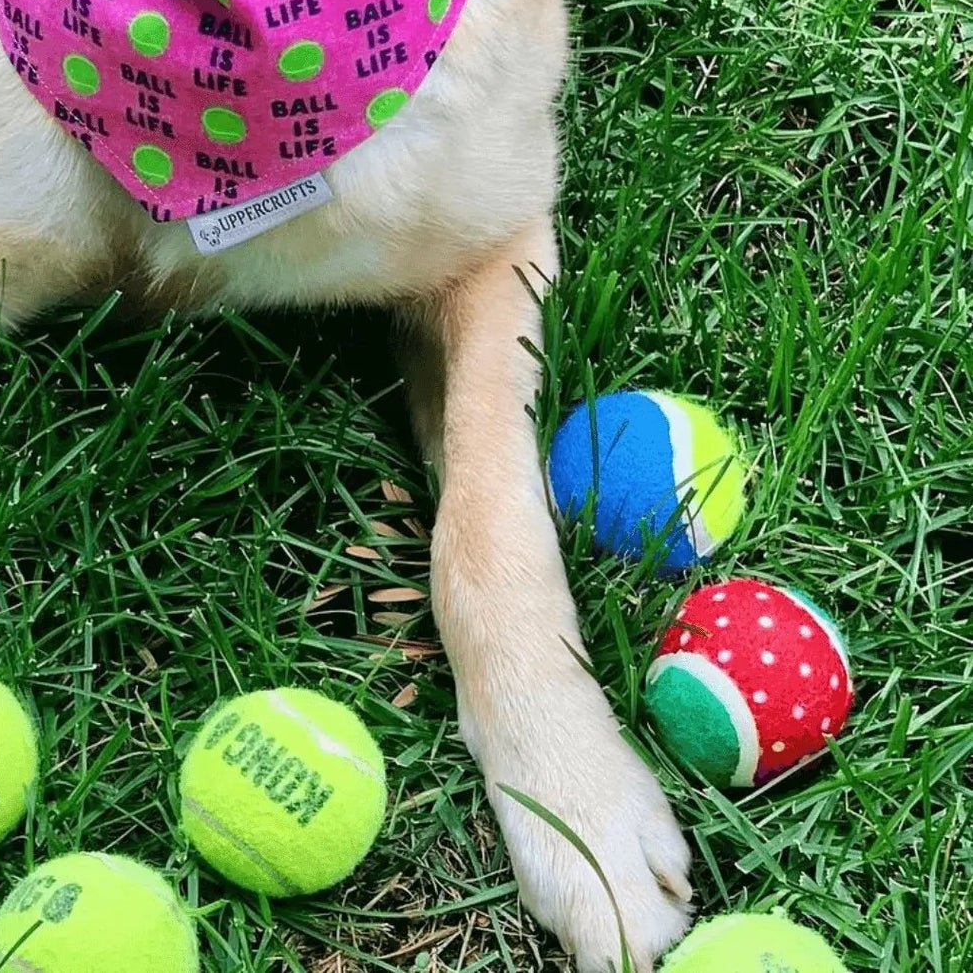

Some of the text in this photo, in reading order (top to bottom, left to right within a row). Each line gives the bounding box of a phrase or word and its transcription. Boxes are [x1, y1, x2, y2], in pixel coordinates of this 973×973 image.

[63, 8, 103, 47] LIFE
[198, 12, 255, 52] BALL
[367, 24, 390, 49] IS
[9, 52, 39, 86] IFE
[210, 46, 234, 71] IS
[355, 42, 408, 79] LIFE
[120, 62, 177, 100] BALL
[194, 68, 248, 97] LIFE
[138, 91, 161, 114] IS
[271, 93, 338, 119] BALL
[54, 100, 110, 138] BALL
[125, 107, 176, 140] LIFE
[294, 118, 320, 138] IS
[279, 137, 338, 159] LIFE
[195, 151, 259, 180] BALL
[213, 177, 239, 199] IS
[217, 179, 318, 233] UPPERCRUFTS
[223, 722, 335, 828] KONG
